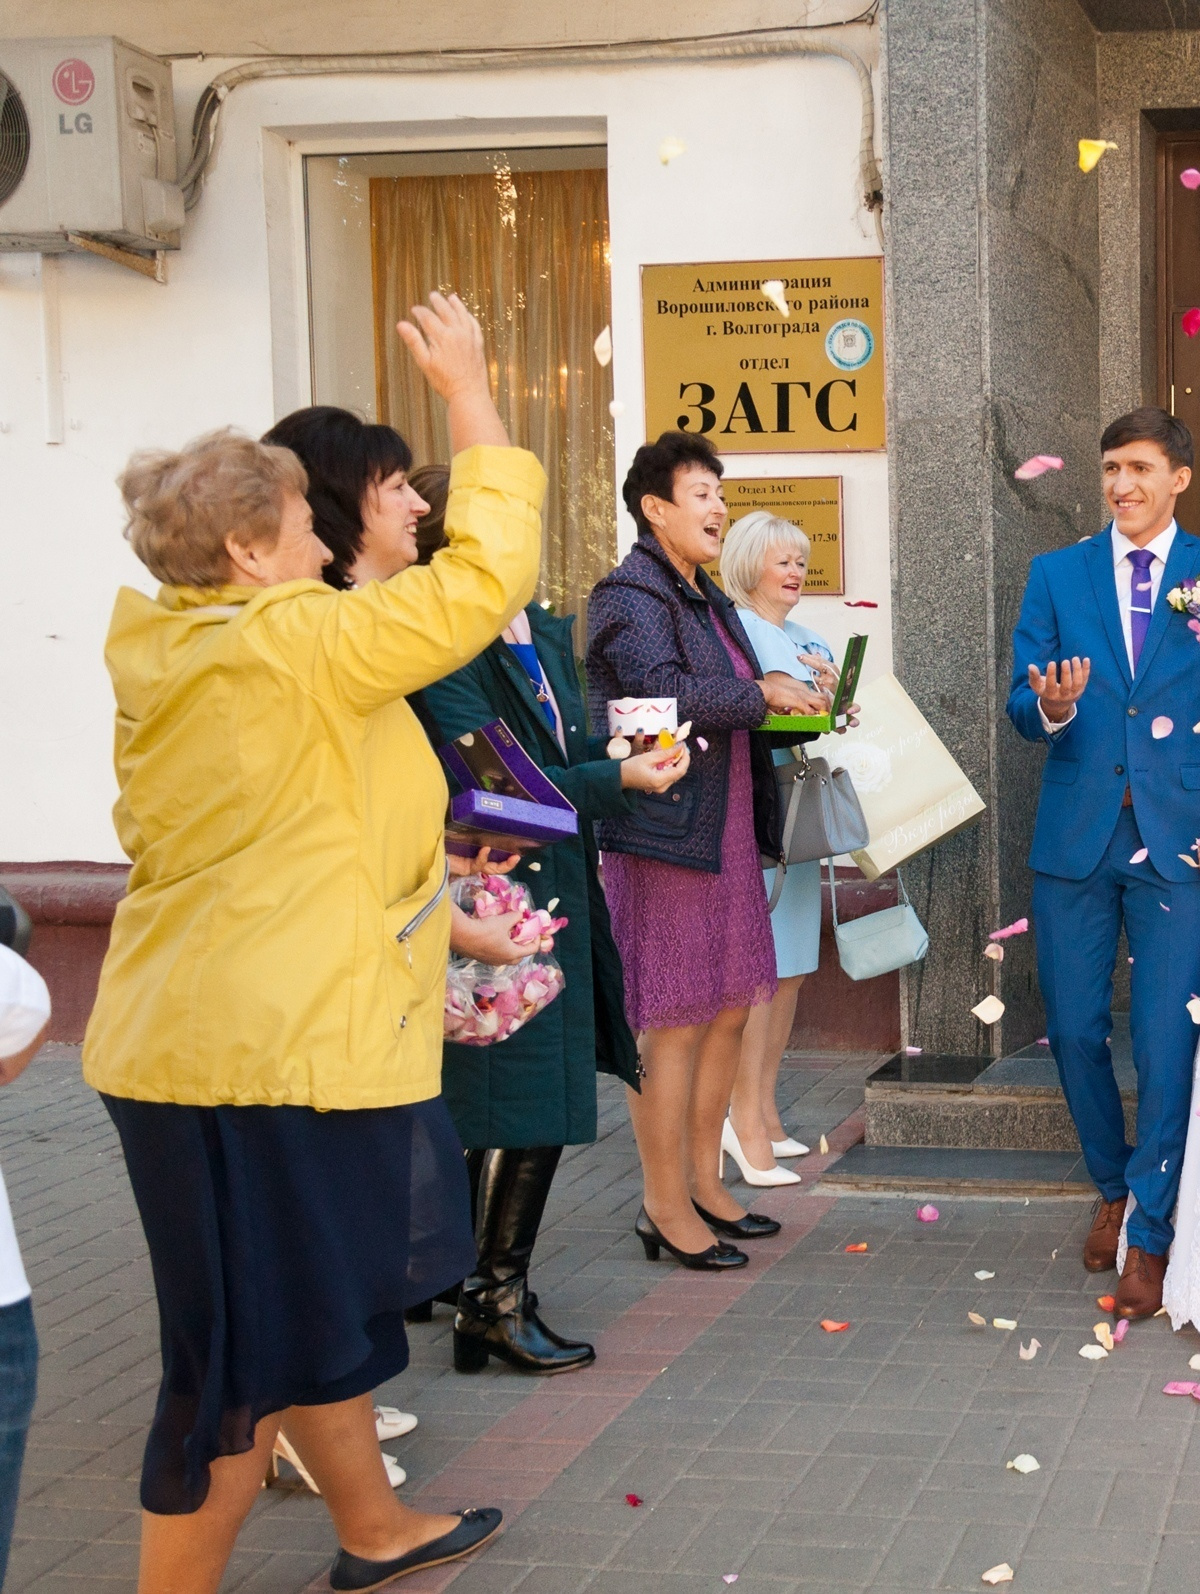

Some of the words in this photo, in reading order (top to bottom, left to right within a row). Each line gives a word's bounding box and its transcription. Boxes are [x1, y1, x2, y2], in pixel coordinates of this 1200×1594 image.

[58, 112, 93, 135] LG
[692, 276, 832, 293] Админирация
[808, 295, 869, 314] района
[706, 324, 717, 336] г.
[722, 320, 820, 338] Волгограда
[739, 357, 790, 371] отдел
[676, 379, 857, 434] ЗАГС
[738, 485, 766, 495] Отдел
[769, 484, 796, 493] ЗАГС
[752, 500, 811, 508] Ворошиловского
[883, 817, 935, 853] Вкус
[938, 793, 973, 830] розы
